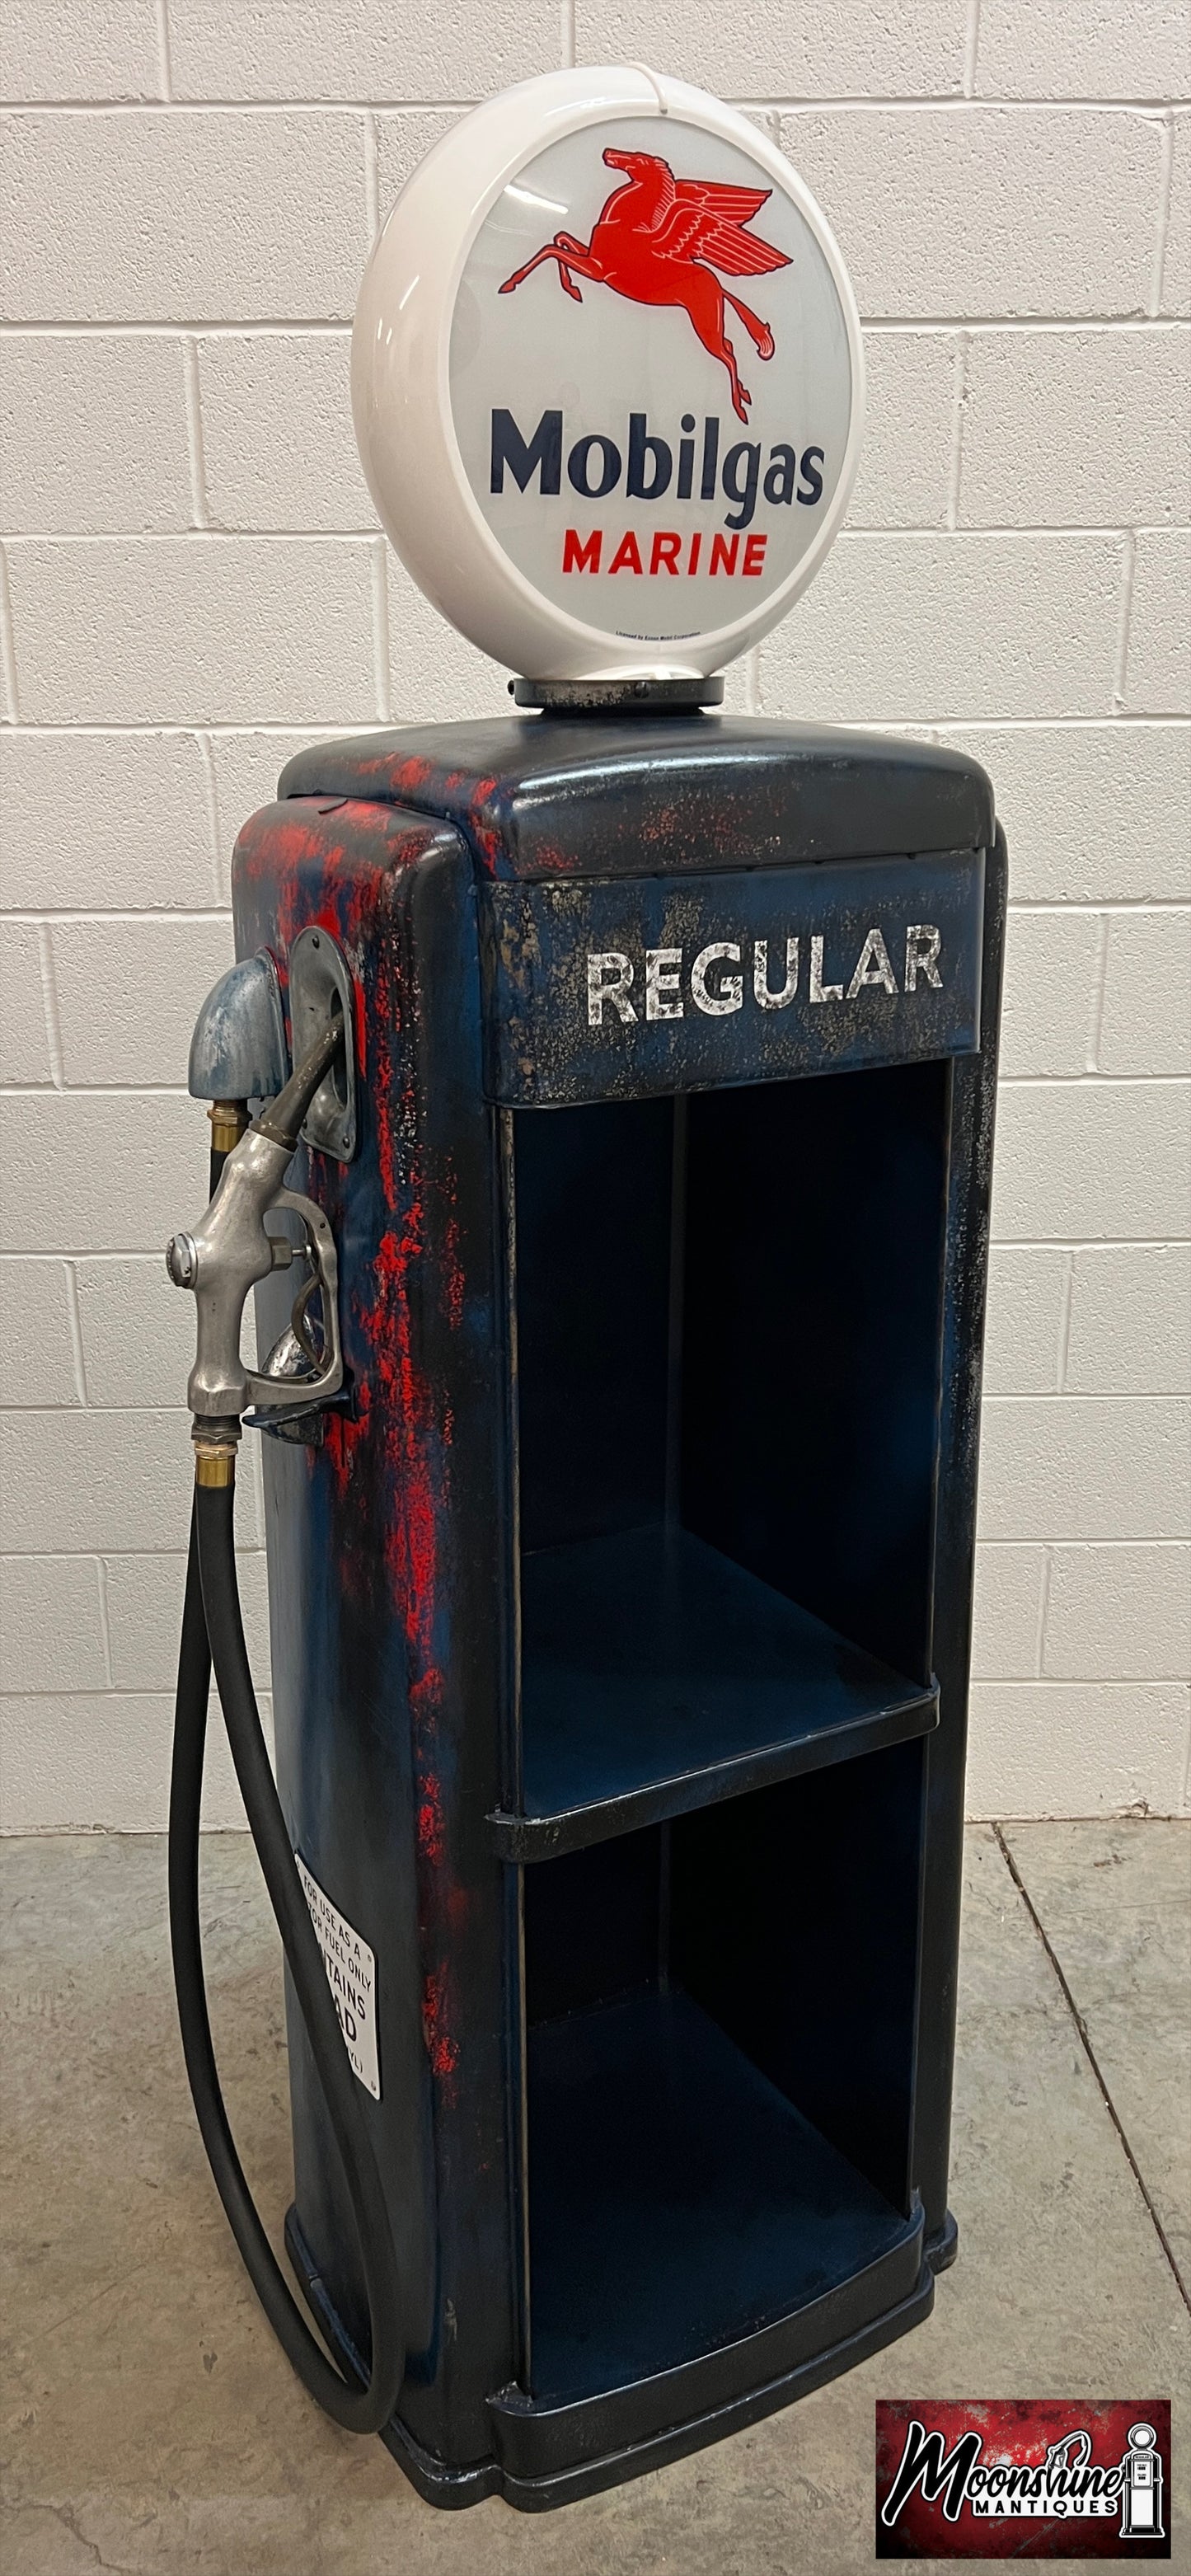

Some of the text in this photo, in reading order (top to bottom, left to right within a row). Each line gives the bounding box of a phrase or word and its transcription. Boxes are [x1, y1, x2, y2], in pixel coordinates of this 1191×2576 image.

[490, 408, 825, 530] Mobilgas
[562, 529, 767, 576] MARINE
[587, 924, 944, 1026] REGULAR
[304, 1875, 361, 1961] FOR USE AS A
[324, 1950, 366, 2020] TAINS
[325, 1926, 345, 1964] FUEL
[348, 1957, 371, 1992] ONLY
